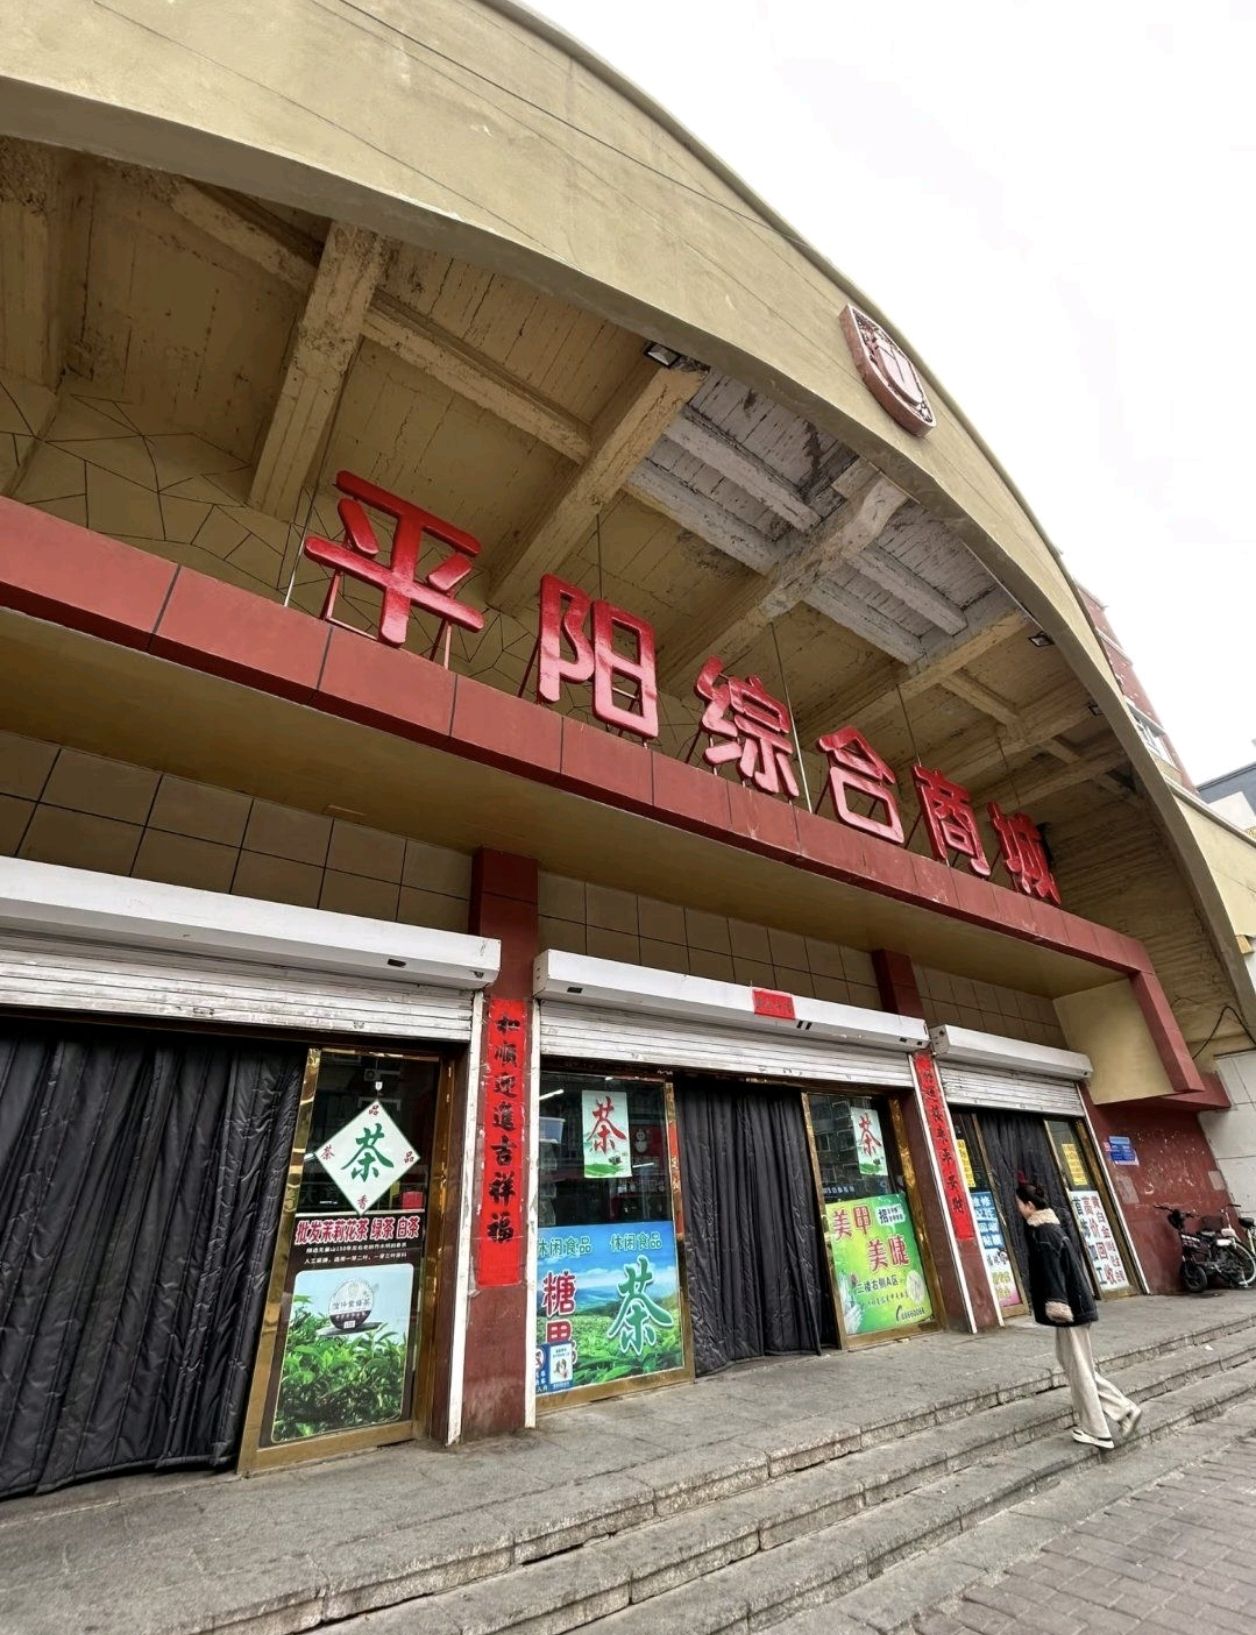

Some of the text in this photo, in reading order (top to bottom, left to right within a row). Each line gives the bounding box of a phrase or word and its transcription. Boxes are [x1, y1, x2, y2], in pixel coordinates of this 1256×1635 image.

[304, 470, 1061, 905] 平阳综合商城
[586, 1095, 628, 1155] 茶
[858, 1112, 882, 1157] 茶
[341, 1123, 394, 1182] 茶
[295, 1215, 420, 1245] 批发茉莉花茶 绿茶 白茶
[609, 1231, 662, 1253] 休闲食品
[832, 1205, 872, 1242] 美甲
[608, 1255, 674, 1357] 茶
